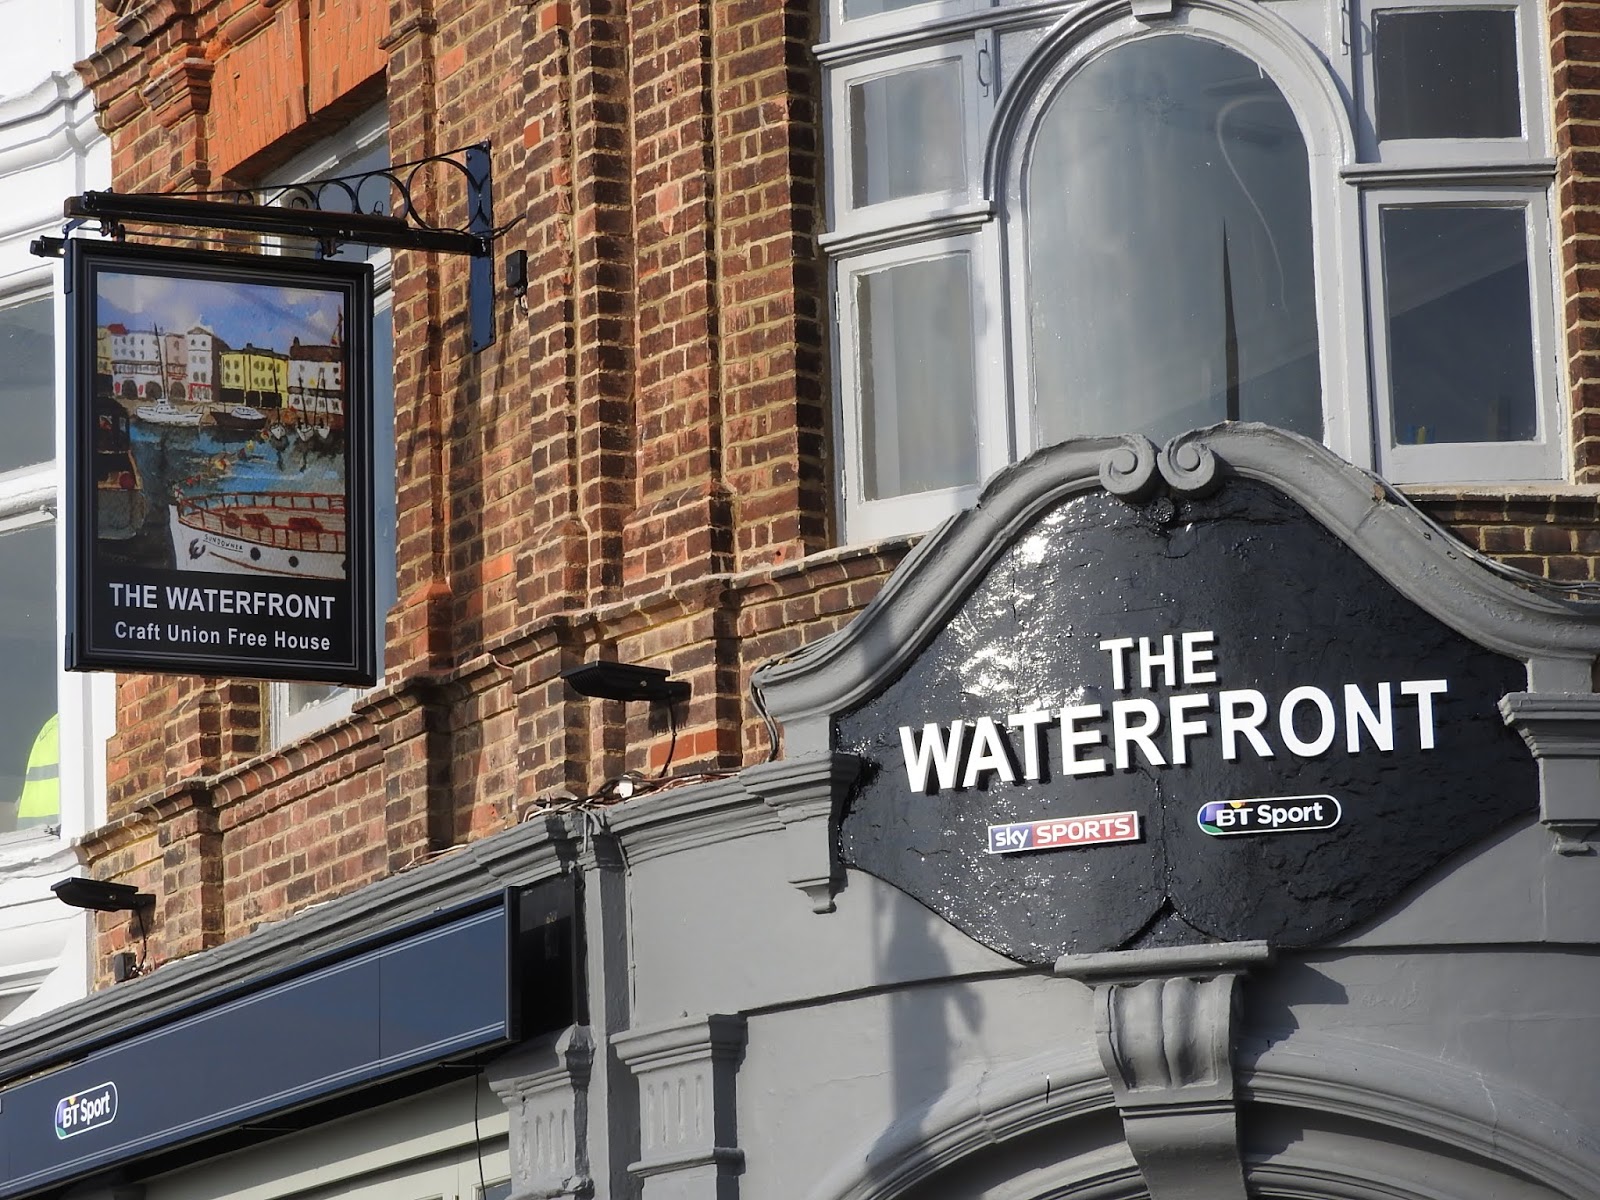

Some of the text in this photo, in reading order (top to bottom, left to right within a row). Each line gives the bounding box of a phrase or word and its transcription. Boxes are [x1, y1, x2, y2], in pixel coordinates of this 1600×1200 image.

[109, 583, 336, 620] THE WATERFRONT
[115, 620, 331, 651] Craft Union Free House
[1100, 630, 1218, 691] THE
[899, 679, 1448, 793] WATERFRONT
[995, 817, 1131, 849] sky SPORTS
[1216, 802, 1323, 828] BT Sport
[62, 1091, 111, 1129] BT Sport
